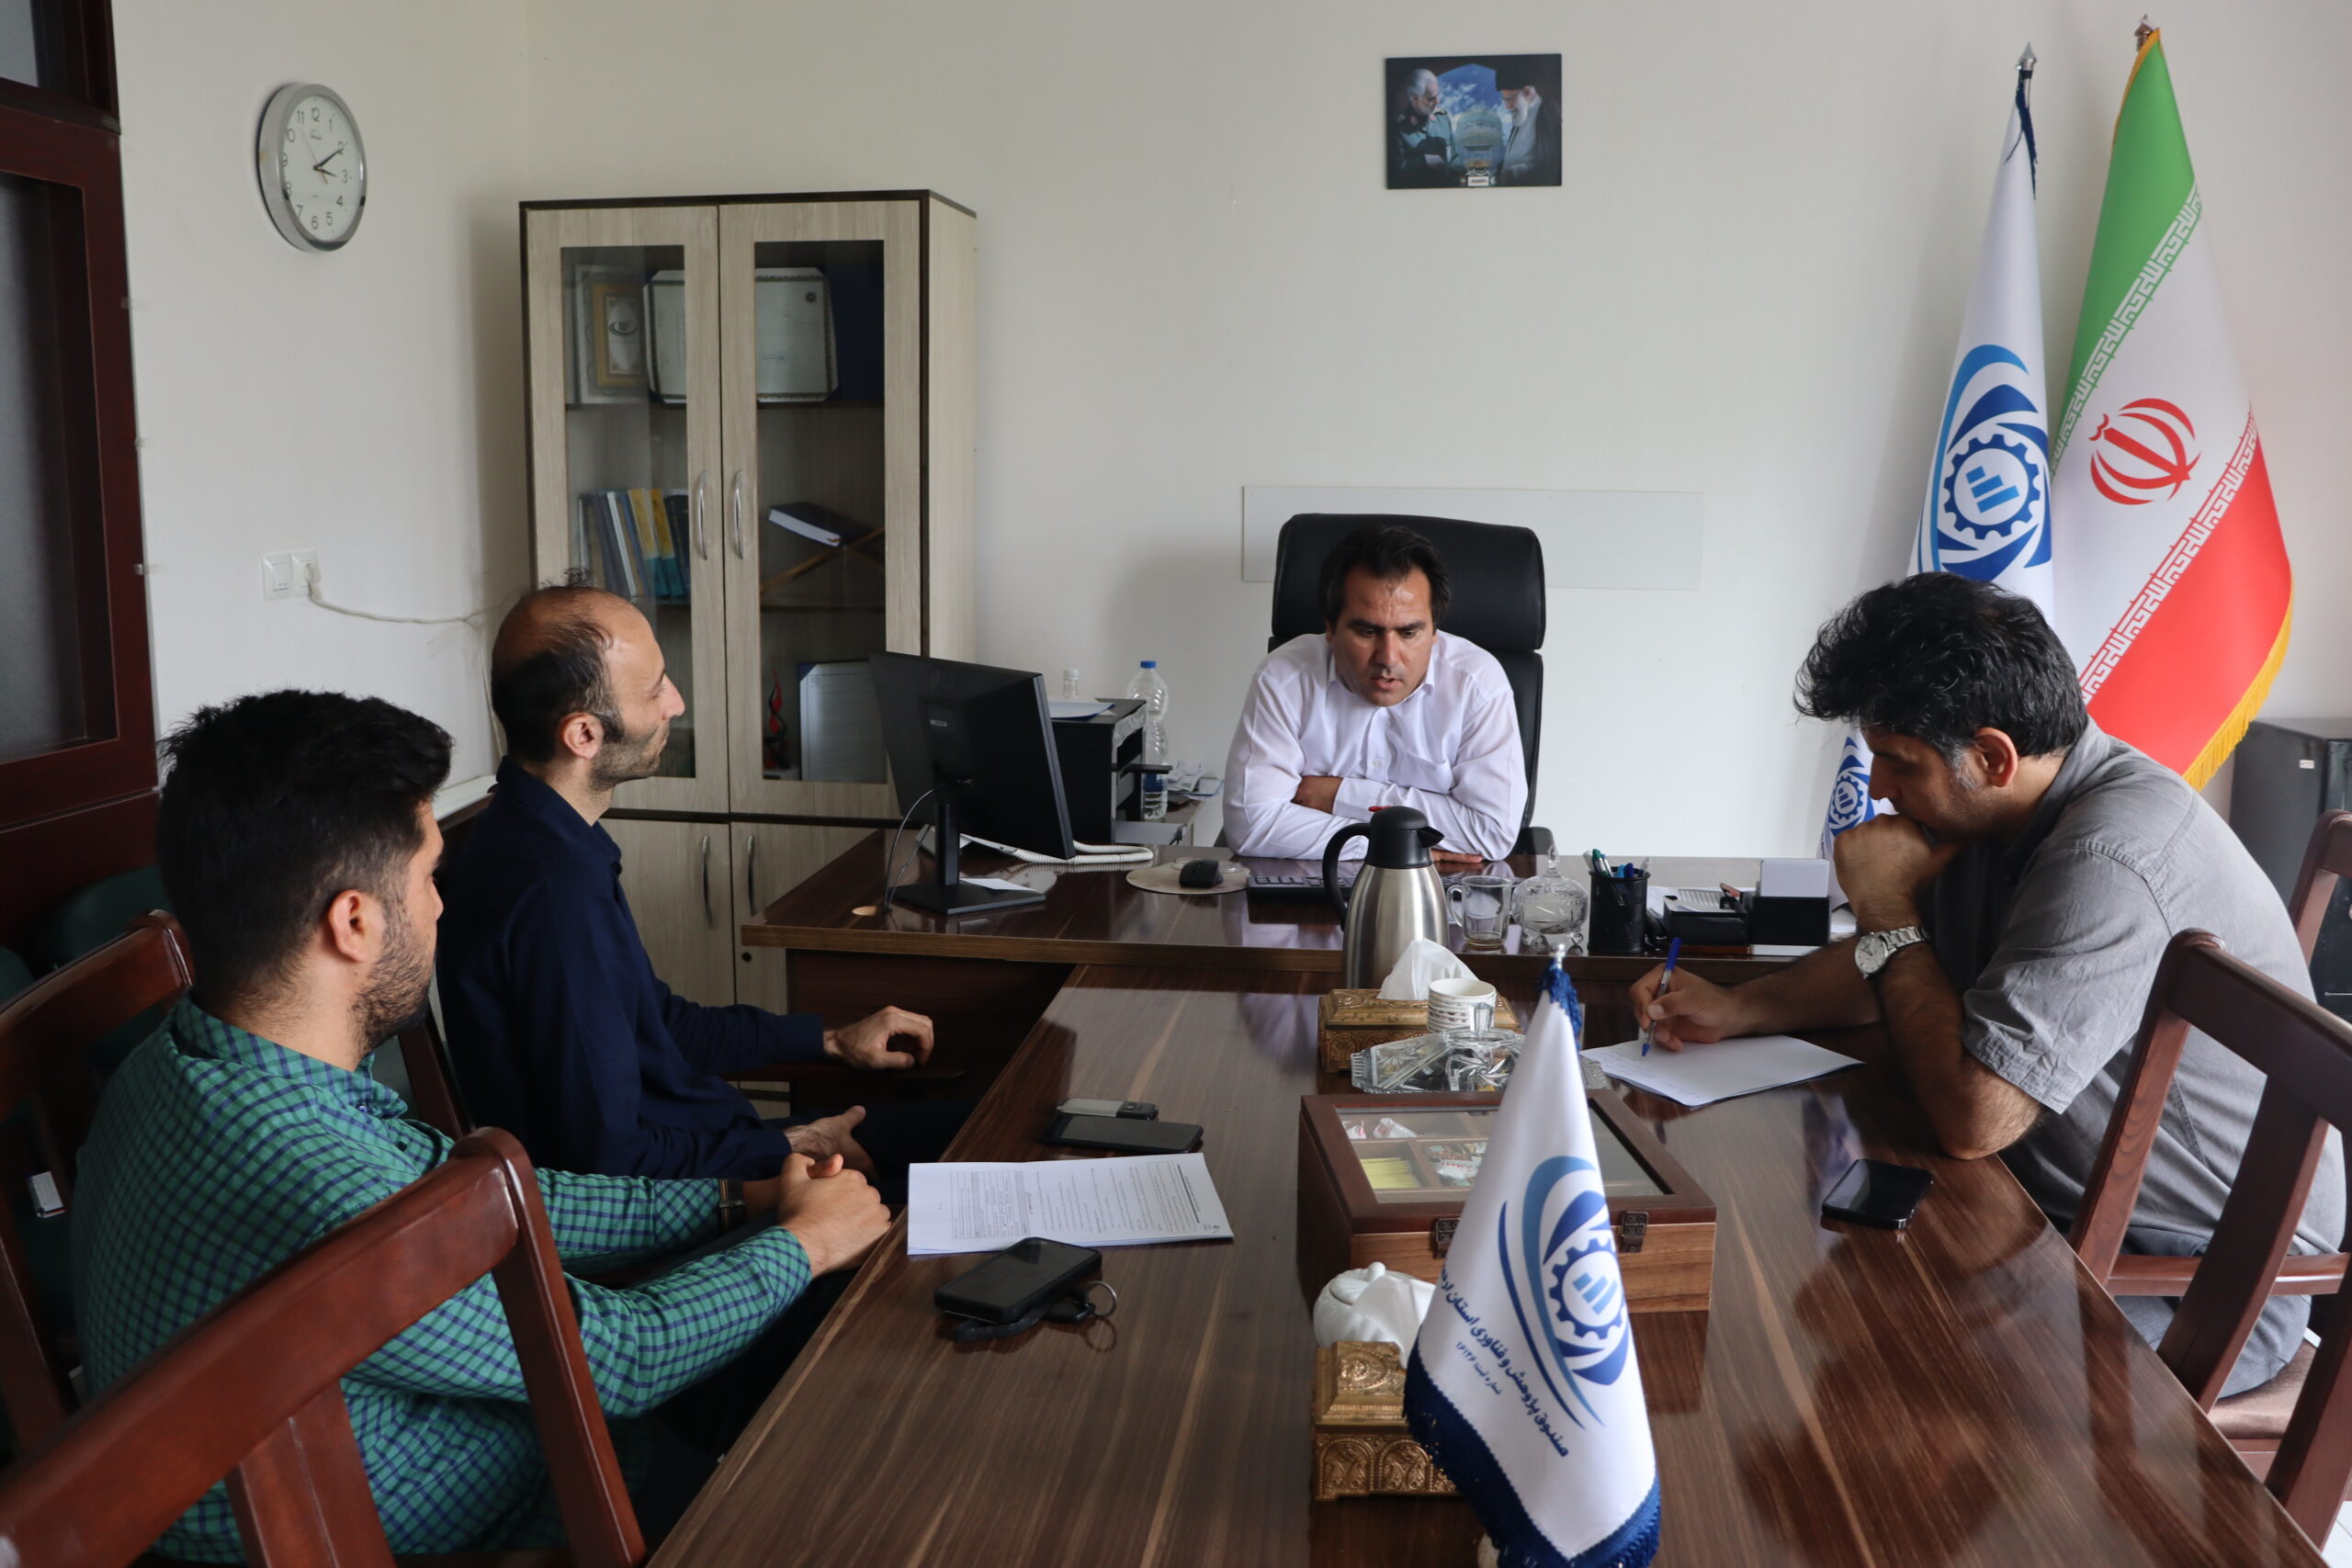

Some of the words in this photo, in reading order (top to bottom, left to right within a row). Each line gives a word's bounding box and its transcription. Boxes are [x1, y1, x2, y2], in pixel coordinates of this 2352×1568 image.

[297, 109, 304, 125] 11
[311, 107, 321, 122] 12
[338, 141, 345, 155] 2
[342, 169, 348, 184] 3
[336, 195, 344, 209] 4
[311, 215, 319, 230] 6
[326, 211, 333, 226] 5
[1445, 1292, 1480, 1325] استان
[1498, 1359, 1510, 1368] و
[1505, 1367, 1539, 1416] پژوهش
[1534, 1413, 1568, 1457] صندوق
